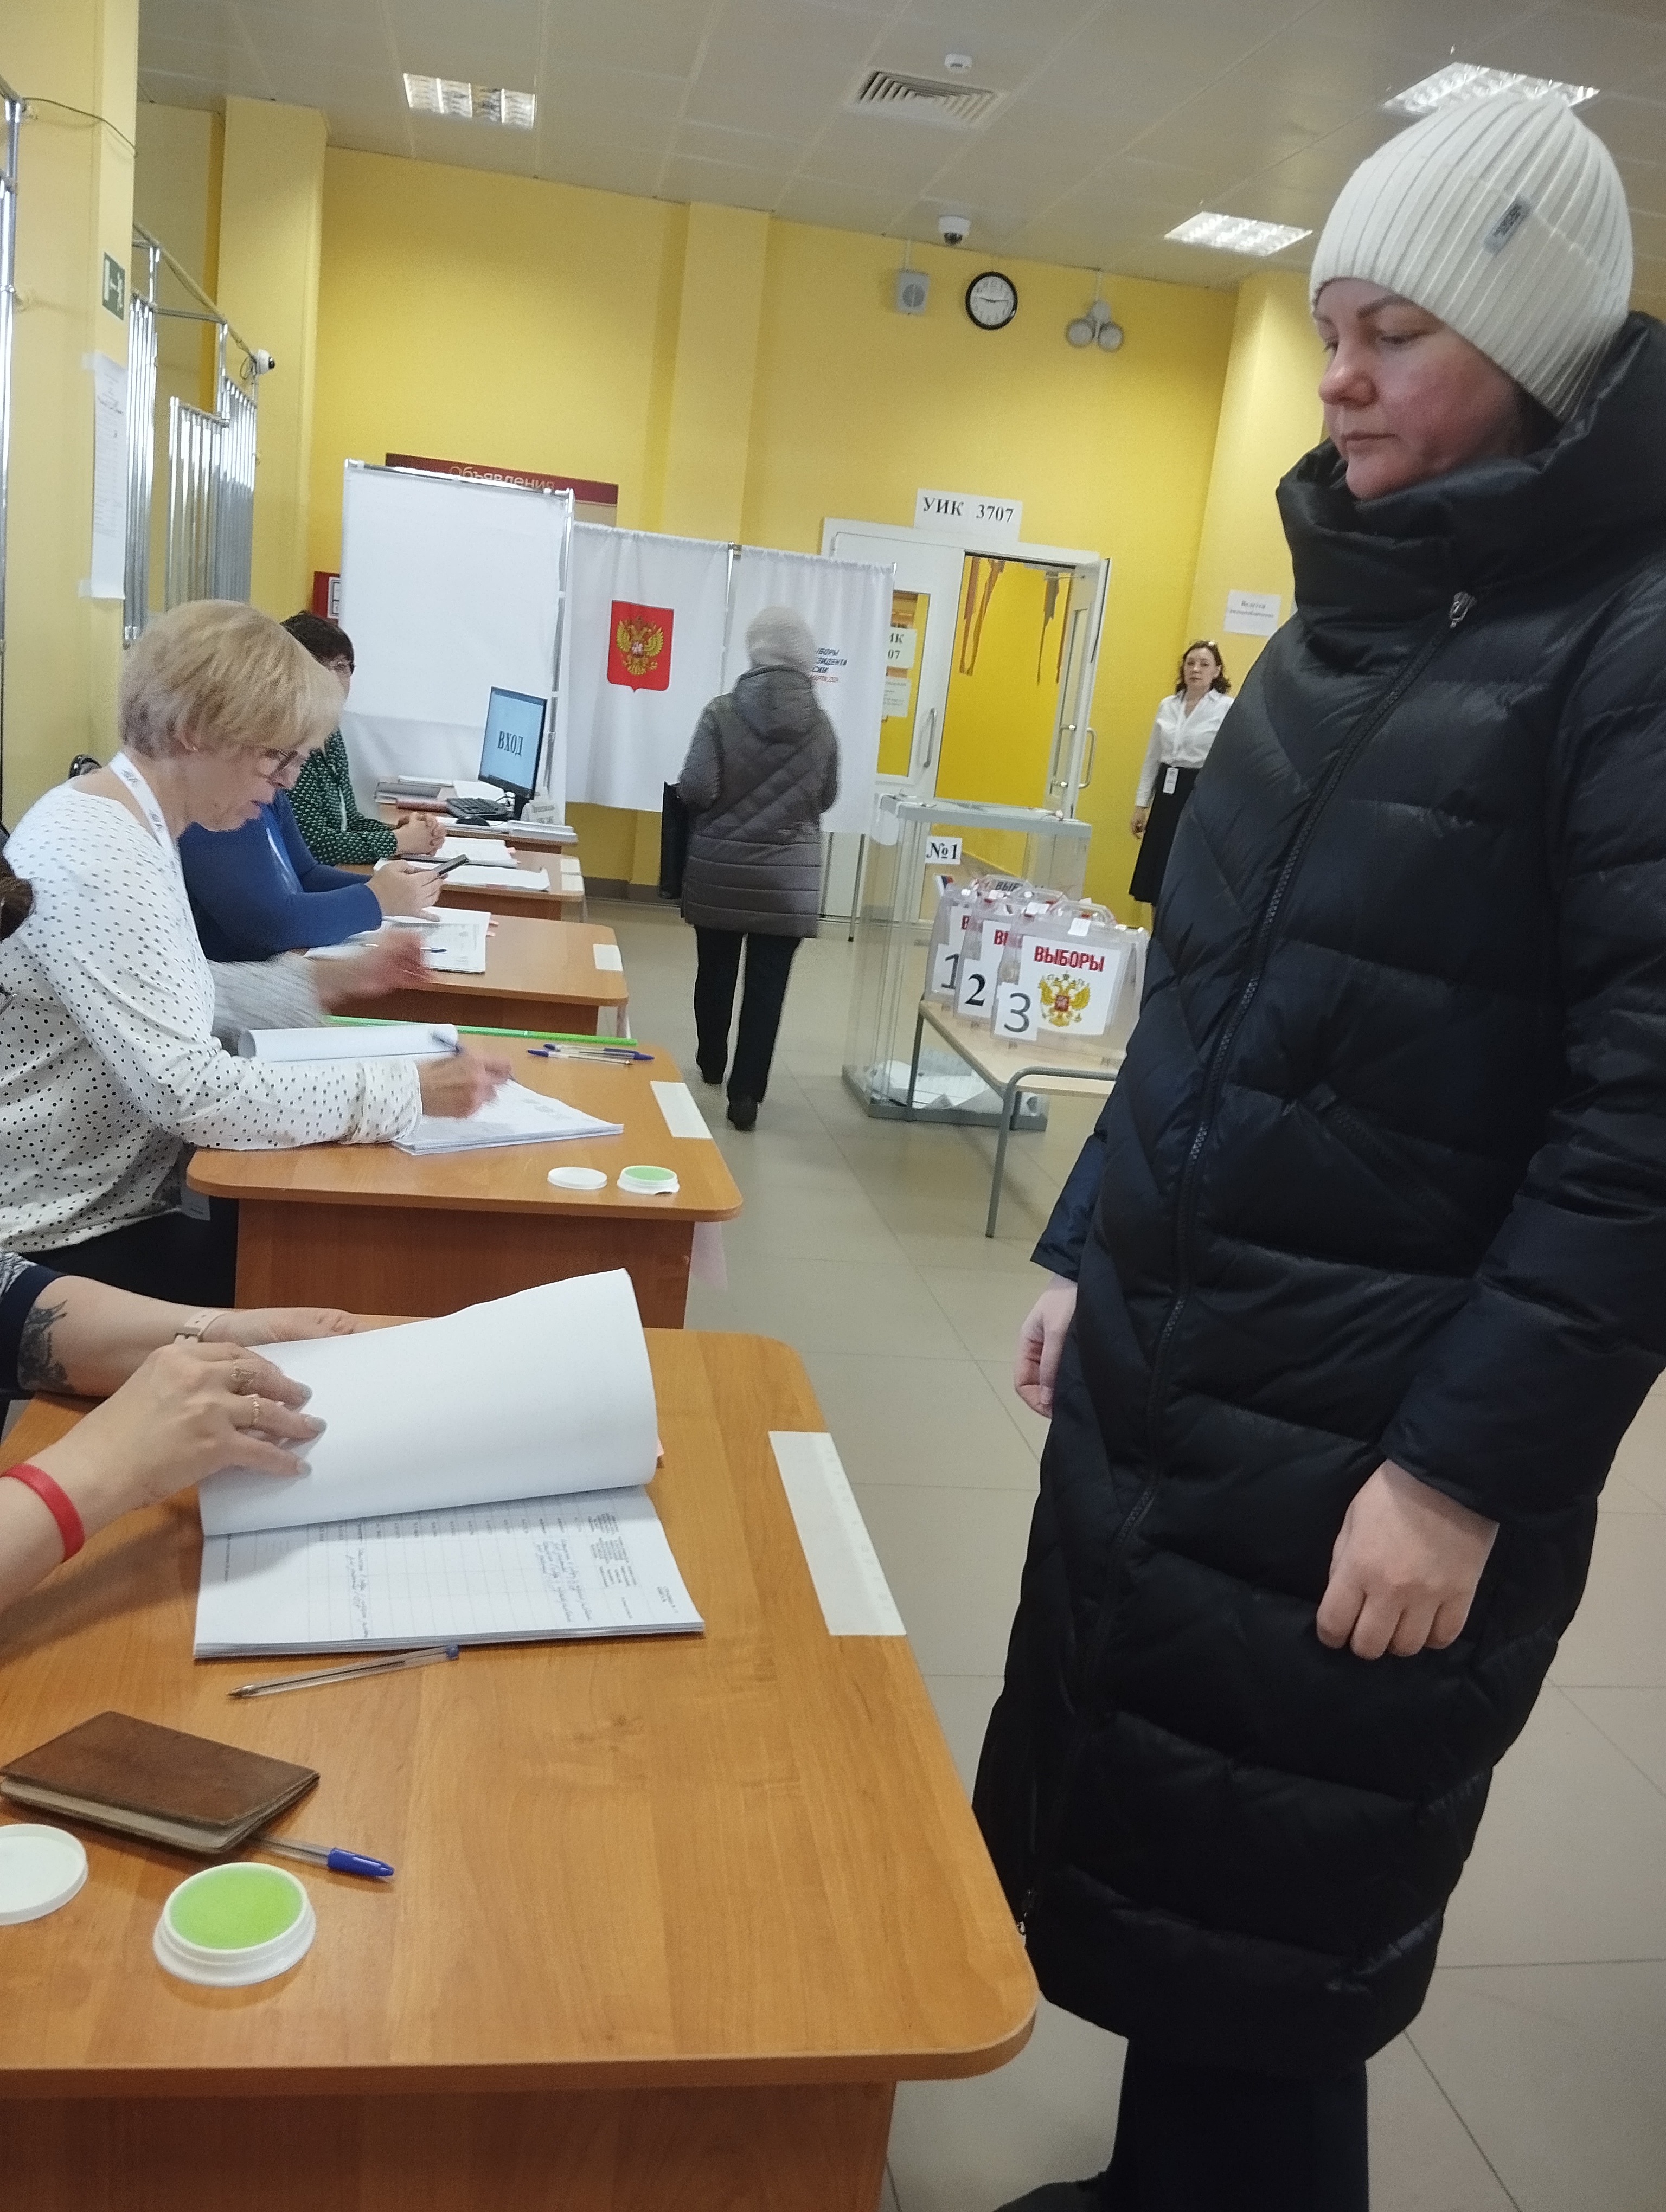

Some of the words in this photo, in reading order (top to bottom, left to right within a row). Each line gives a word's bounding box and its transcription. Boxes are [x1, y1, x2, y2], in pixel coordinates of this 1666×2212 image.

[922, 497, 964, 517] УИК
[976, 504, 1015, 523] 3707
[887, 649, 901, 659] 07
[497, 730, 524, 756] ВХОД
[926, 841, 959, 860] №1
[941, 953, 960, 990] 1
[1034, 946, 1105, 973] ВЫБОРЫ
[965, 973, 986, 1007] 2
[1004, 992, 1030, 1033] 3
